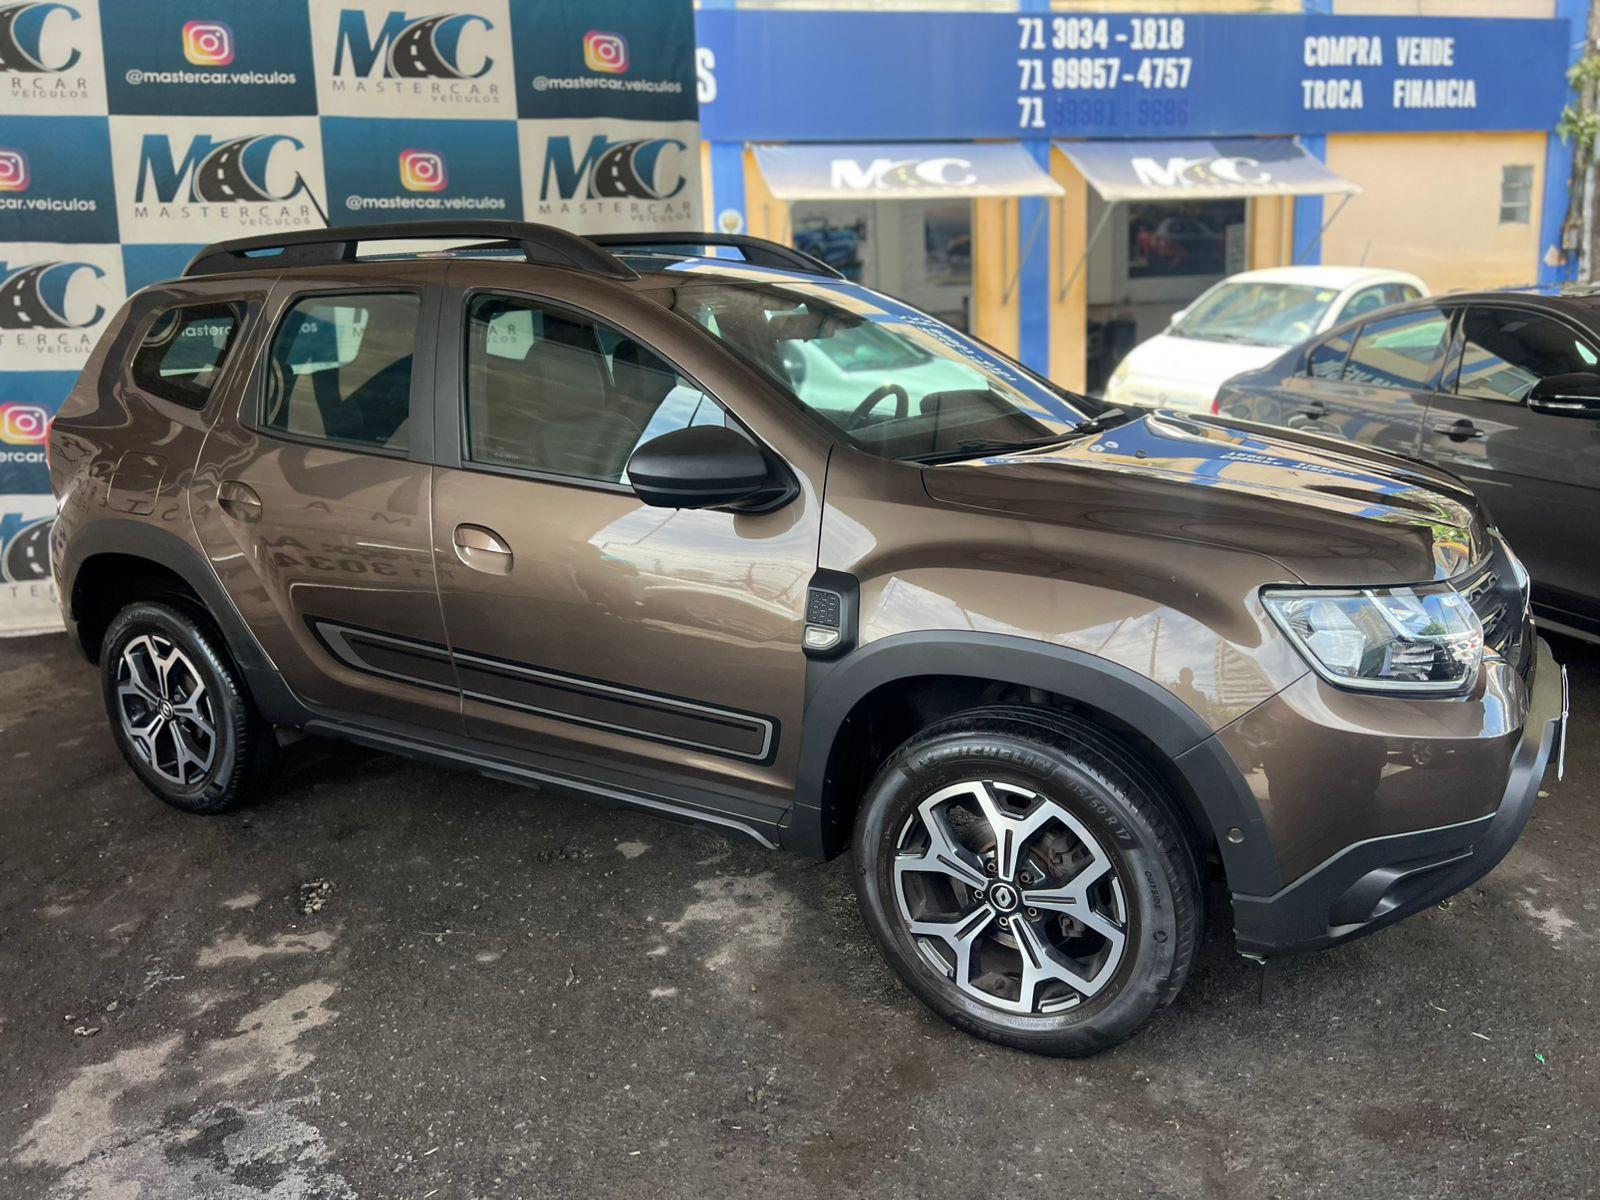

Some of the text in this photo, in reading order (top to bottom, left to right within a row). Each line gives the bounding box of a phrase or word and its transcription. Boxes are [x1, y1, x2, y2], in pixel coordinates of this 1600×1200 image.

[1017, 18, 1046, 50] 71
[1052, 18, 1109, 50] 3034
[1303, 36, 1455, 67] COMPRA VENDE
[125, 68, 297, 86] @mastercar.veiculos
[532, 75, 682, 94] @mastercar.veiculos
[1017, 59, 1046, 91] 71
[332, 80, 499, 94] MASTERCAR
[1301, 79, 1477, 110] TROCA FINANCIA
[1017, 97, 1046, 128] 71
[134, 205, 310, 218] MASTERCAR
[345, 194, 506, 211] @mastercar.veiculos
[538, 201, 691, 215] MASTERCAR
